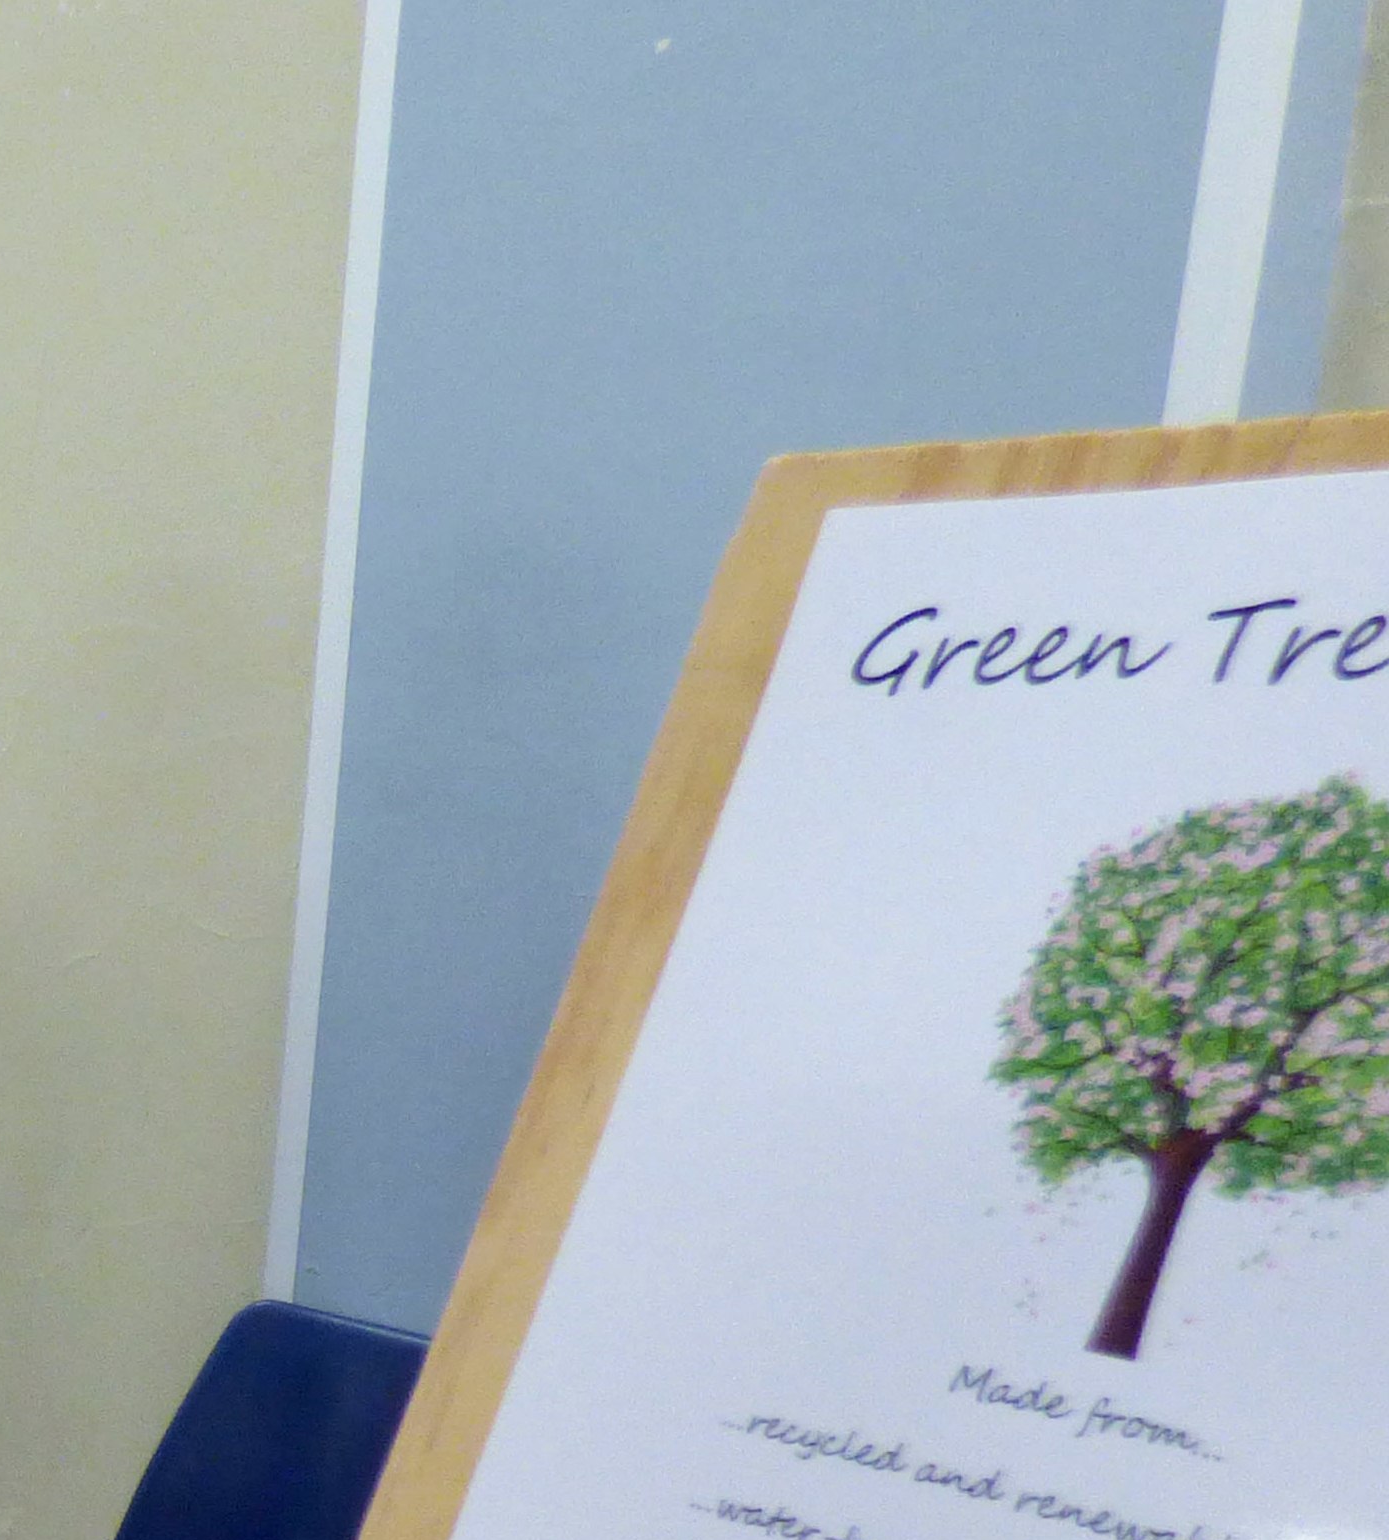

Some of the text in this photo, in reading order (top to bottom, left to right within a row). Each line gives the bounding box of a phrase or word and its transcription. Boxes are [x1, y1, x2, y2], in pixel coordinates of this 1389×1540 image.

[851, 598, 1389, 696] Green Tre
[950, 1365, 1073, 1419] Made
[914, 1461, 1005, 1501] and
